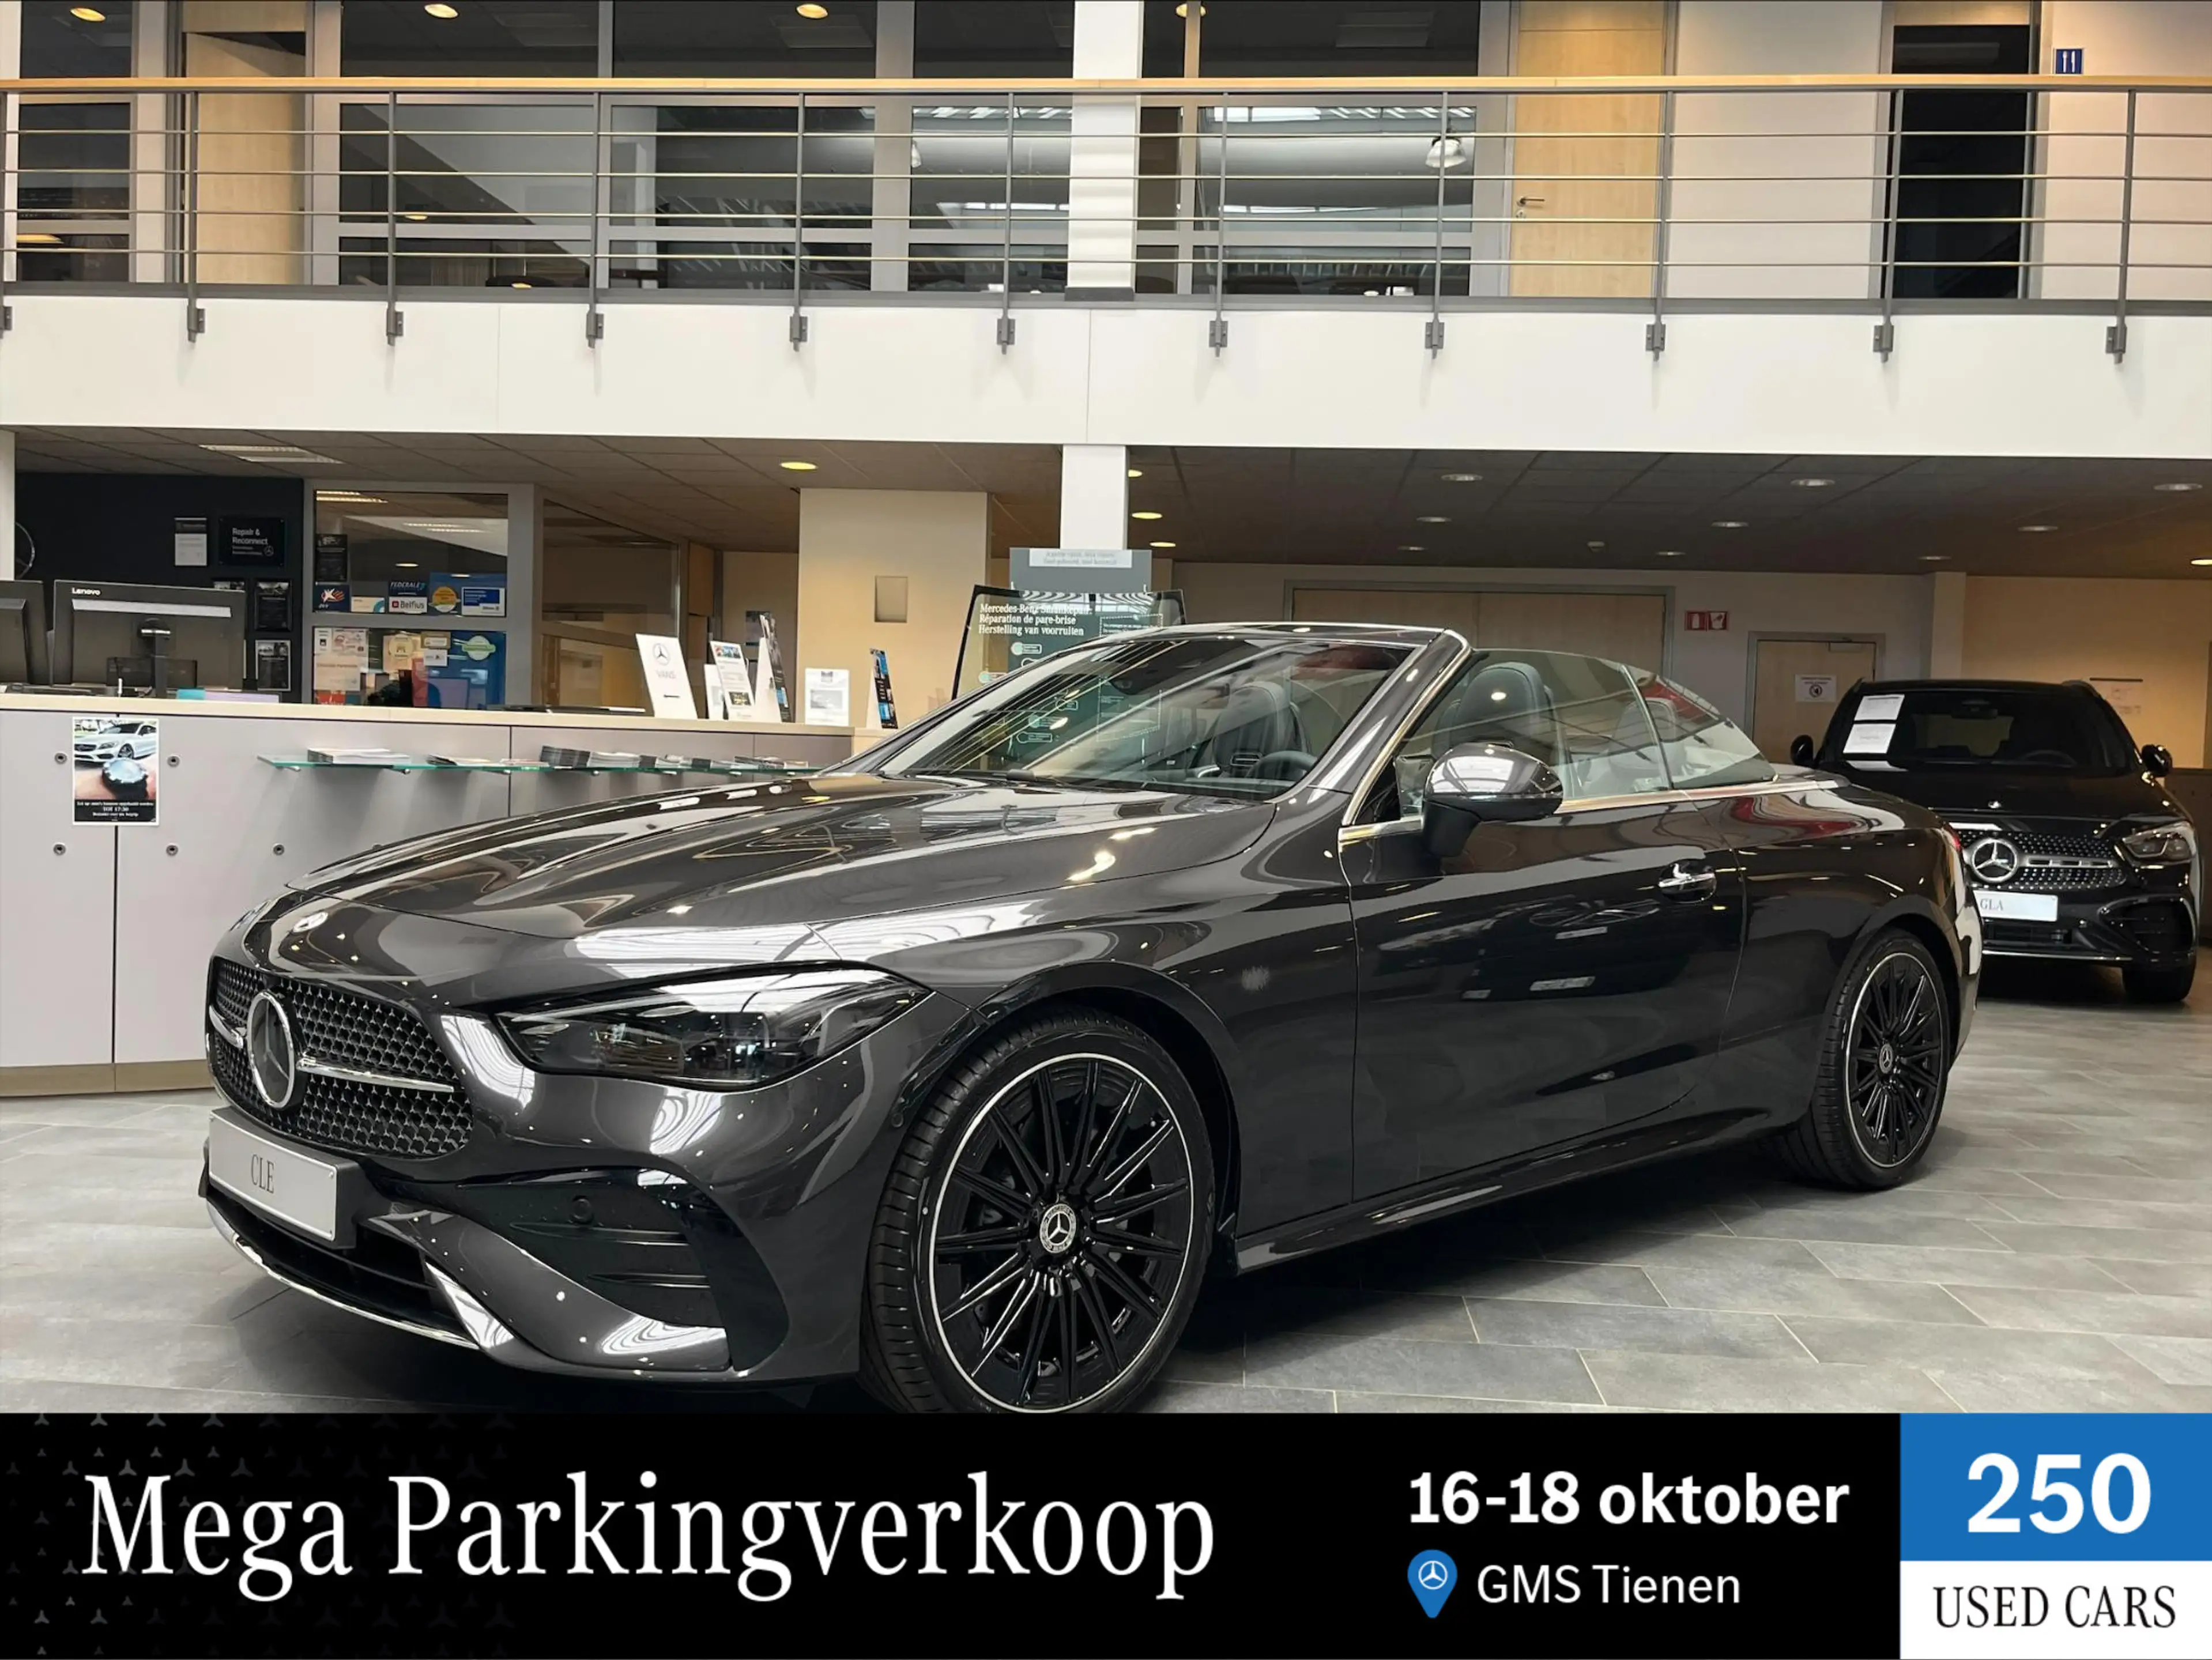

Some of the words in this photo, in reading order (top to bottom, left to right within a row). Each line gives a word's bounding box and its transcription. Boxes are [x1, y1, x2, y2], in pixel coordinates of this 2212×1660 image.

[232, 527, 254, 536] Repair
[255, 528, 261, 536] &
[71, 587, 101, 595] Lenovo
[401, 599, 425, 609] Belfius
[979, 602, 1039, 614] Mercedes-Benz
[979, 613, 1022, 625] Réparation
[1023, 615, 1034, 624] de
[1035, 615, 1076, 625] pare-brise
[978, 624, 1022, 636] Herstelling
[1024, 627, 1039, 635] van
[1041, 626, 1084, 636] voorruiten
[1980, 898, 2004, 911] GLA
[250, 1153, 275, 1194] CLE
